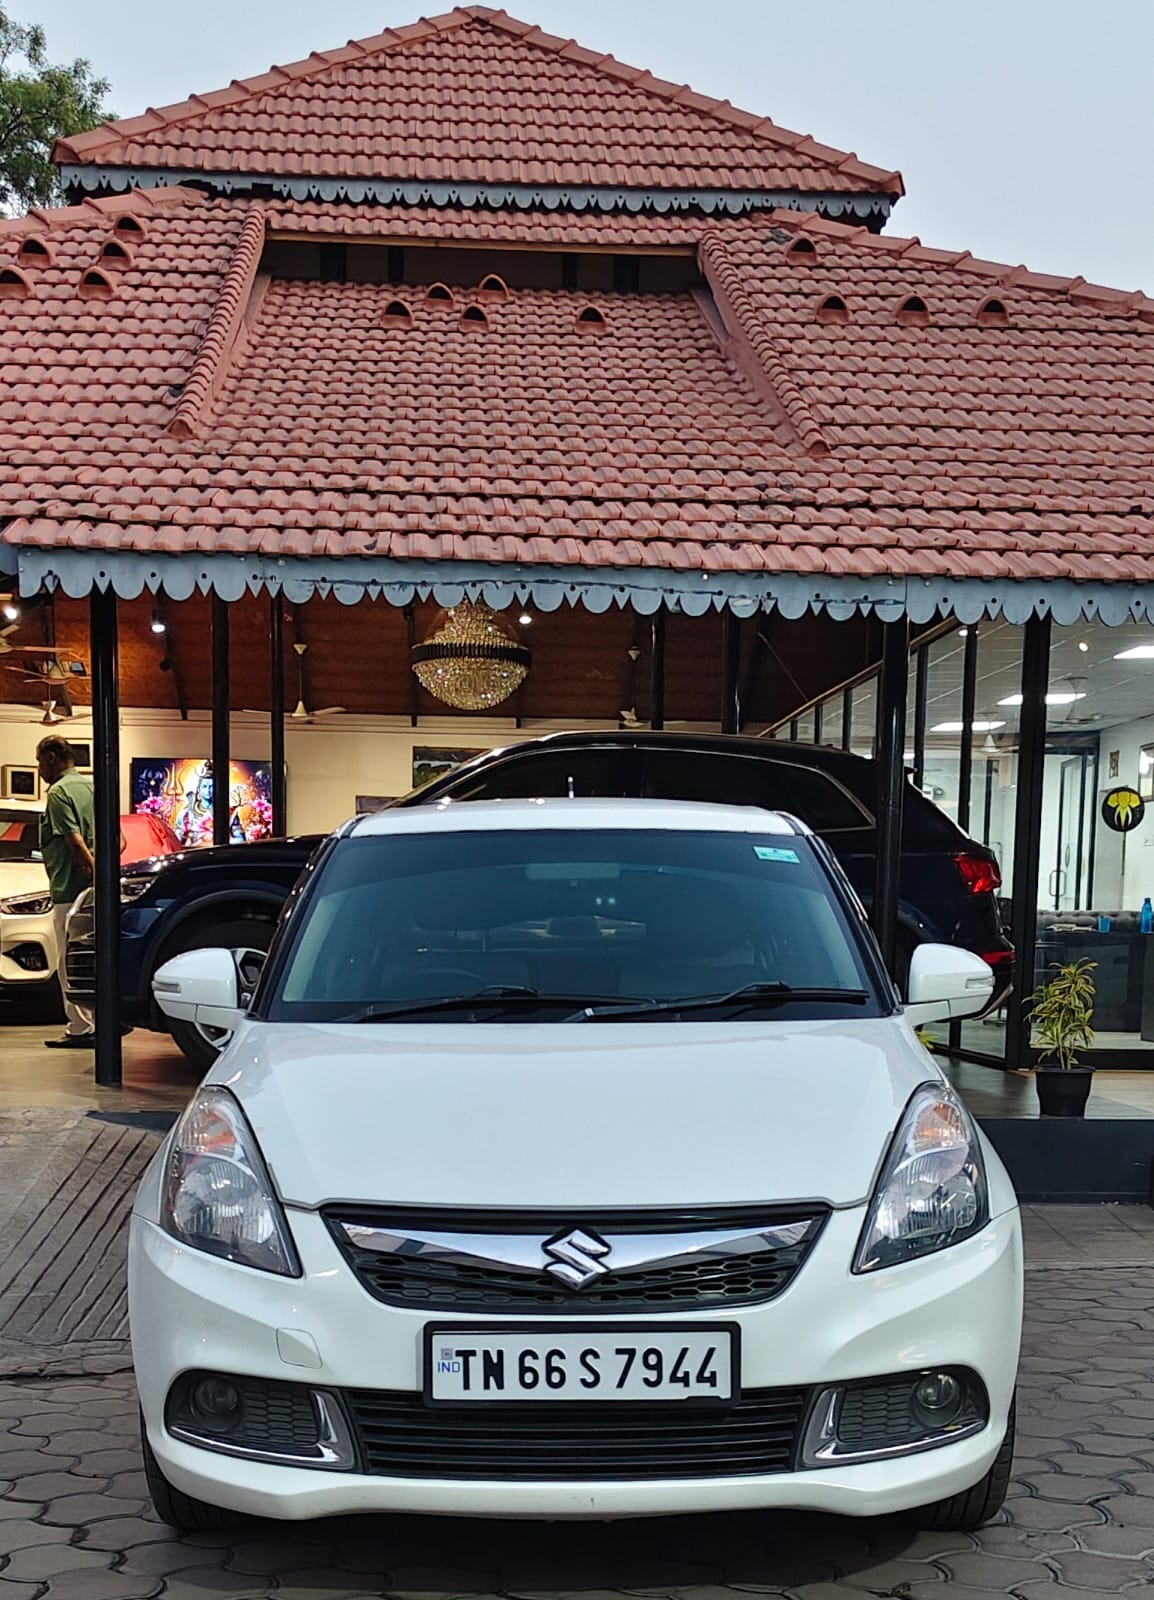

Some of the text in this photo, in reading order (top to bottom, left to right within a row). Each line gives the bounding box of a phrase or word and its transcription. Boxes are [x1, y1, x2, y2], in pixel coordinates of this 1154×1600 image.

[437, 1361, 461, 1373] IND
[455, 1347, 717, 1390] TN 66 S 7944
